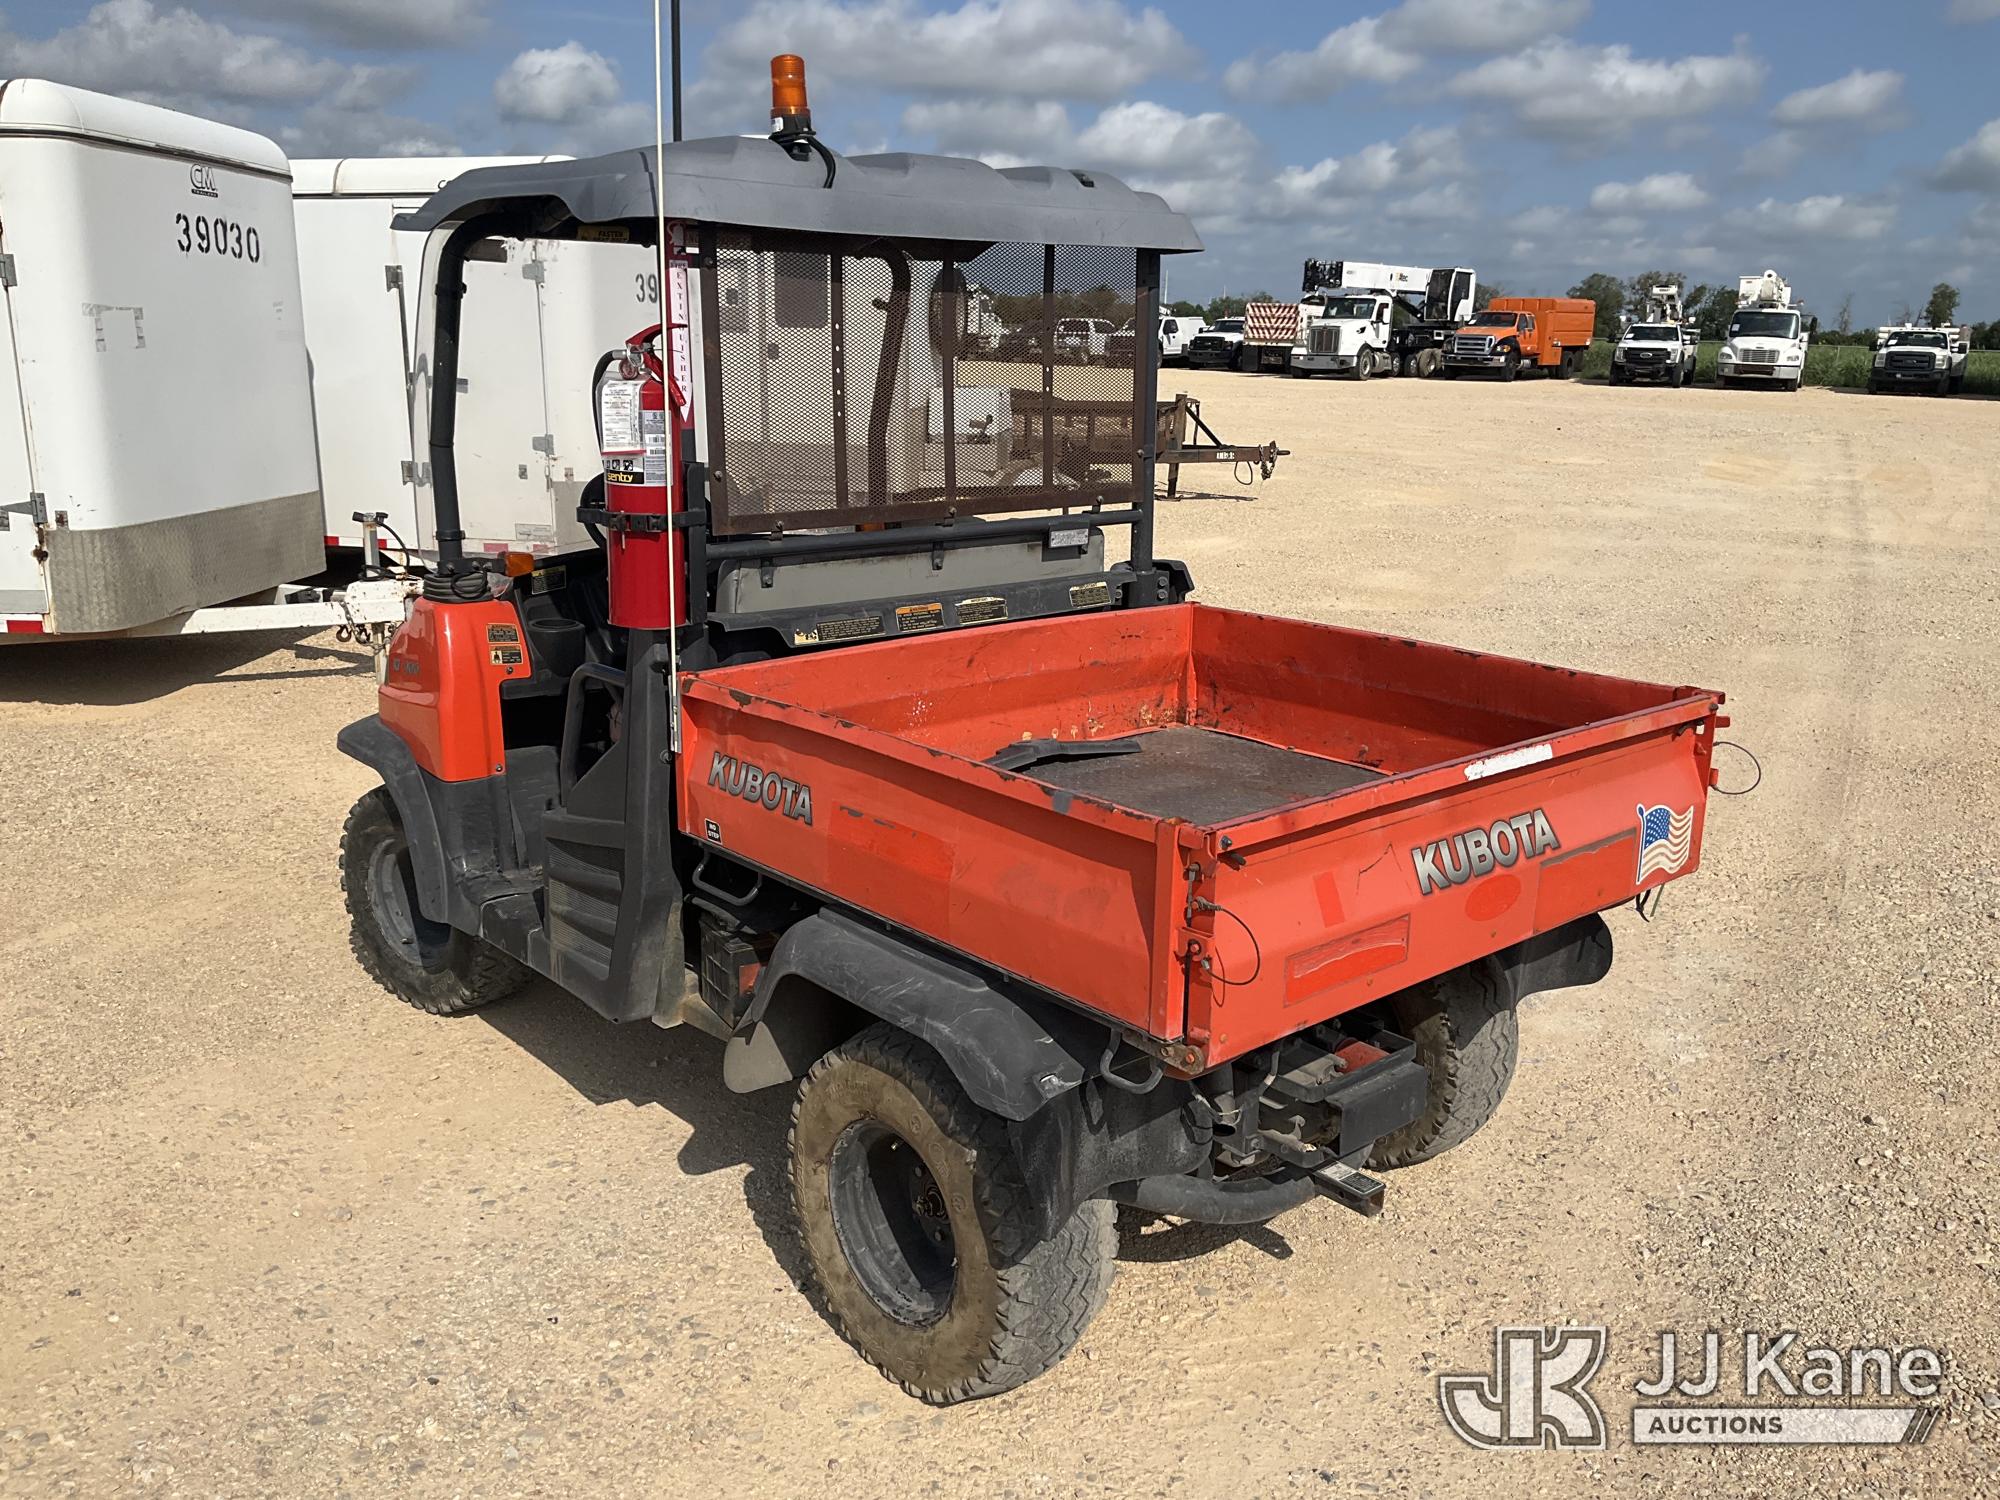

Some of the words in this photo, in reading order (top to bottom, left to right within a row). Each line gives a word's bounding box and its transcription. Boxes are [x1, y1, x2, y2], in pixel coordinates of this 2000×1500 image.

[176, 212, 260, 263] 39030
[607, 472, 634, 483] sentry
[708, 751, 812, 825] KUBOTA
[707, 830, 720, 839] STEP
[708, 823, 717, 831] NO
[1411, 808, 1562, 895] KUBOTA
